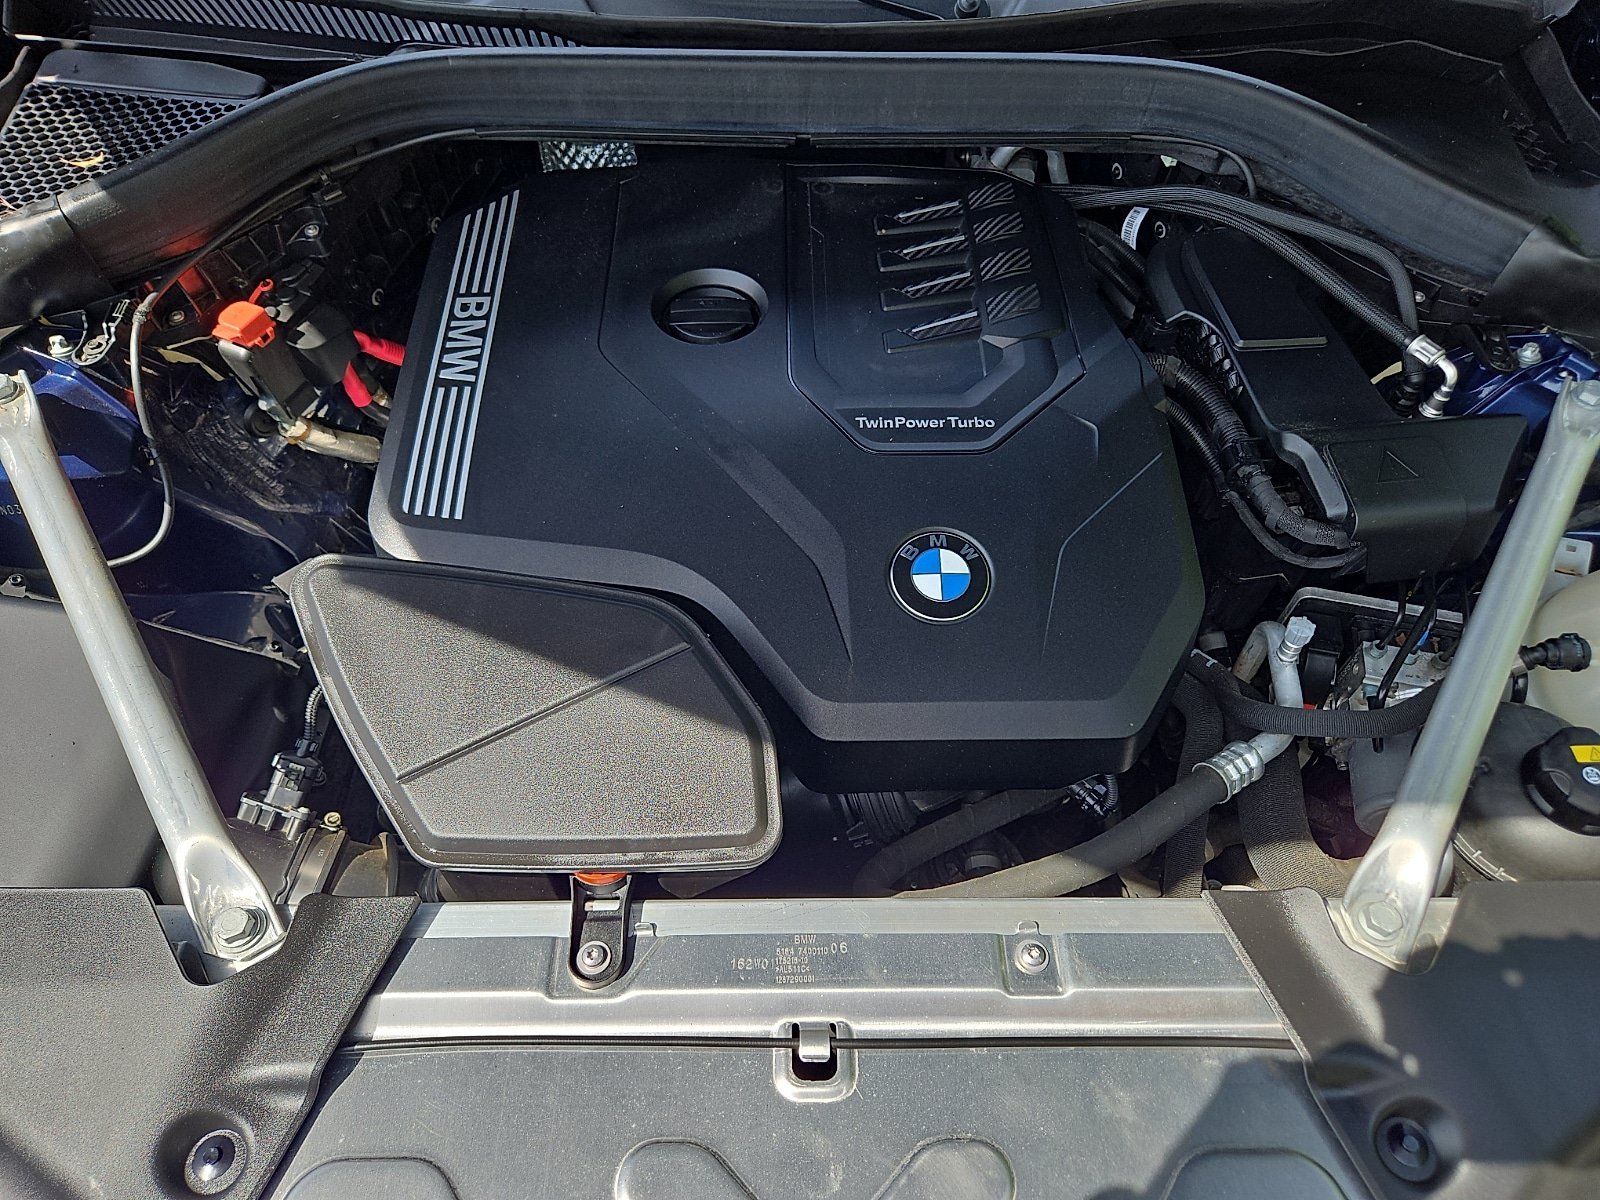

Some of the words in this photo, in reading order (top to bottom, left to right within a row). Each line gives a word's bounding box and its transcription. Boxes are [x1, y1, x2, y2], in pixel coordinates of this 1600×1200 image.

[439, 296, 491, 382] BMW
[900, 534, 979, 561] BMW
[794, 934, 817, 944] BMW
